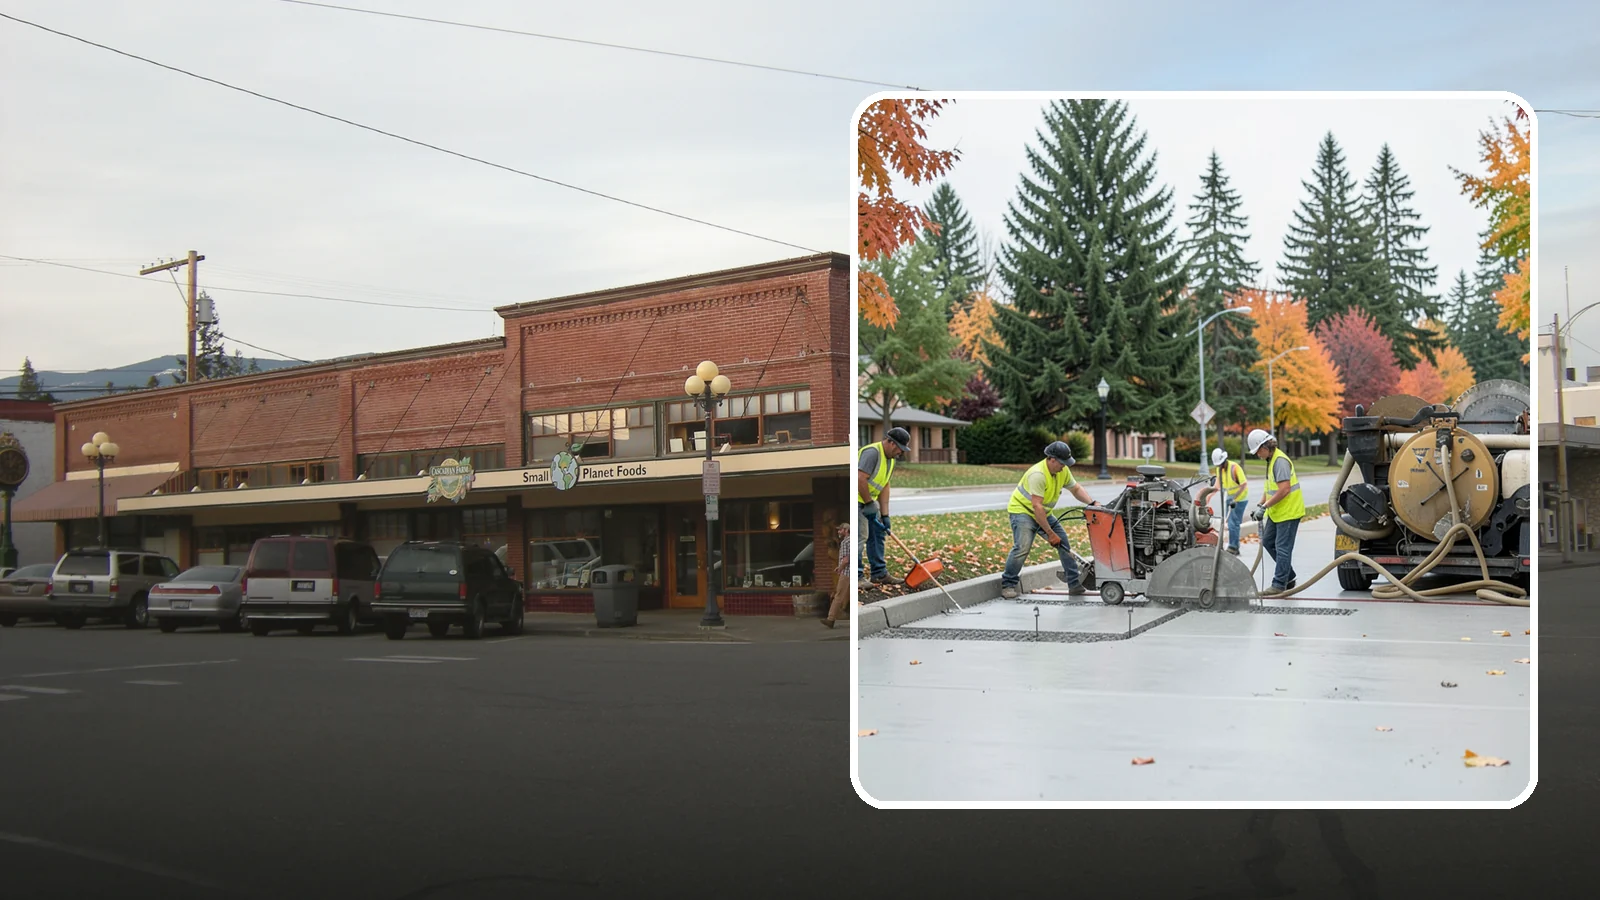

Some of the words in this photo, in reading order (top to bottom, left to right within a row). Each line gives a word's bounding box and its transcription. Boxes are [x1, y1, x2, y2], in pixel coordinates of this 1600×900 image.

[522, 470, 549, 483] Small
[582, 467, 614, 479] Planet
[616, 464, 647, 477] Foods
